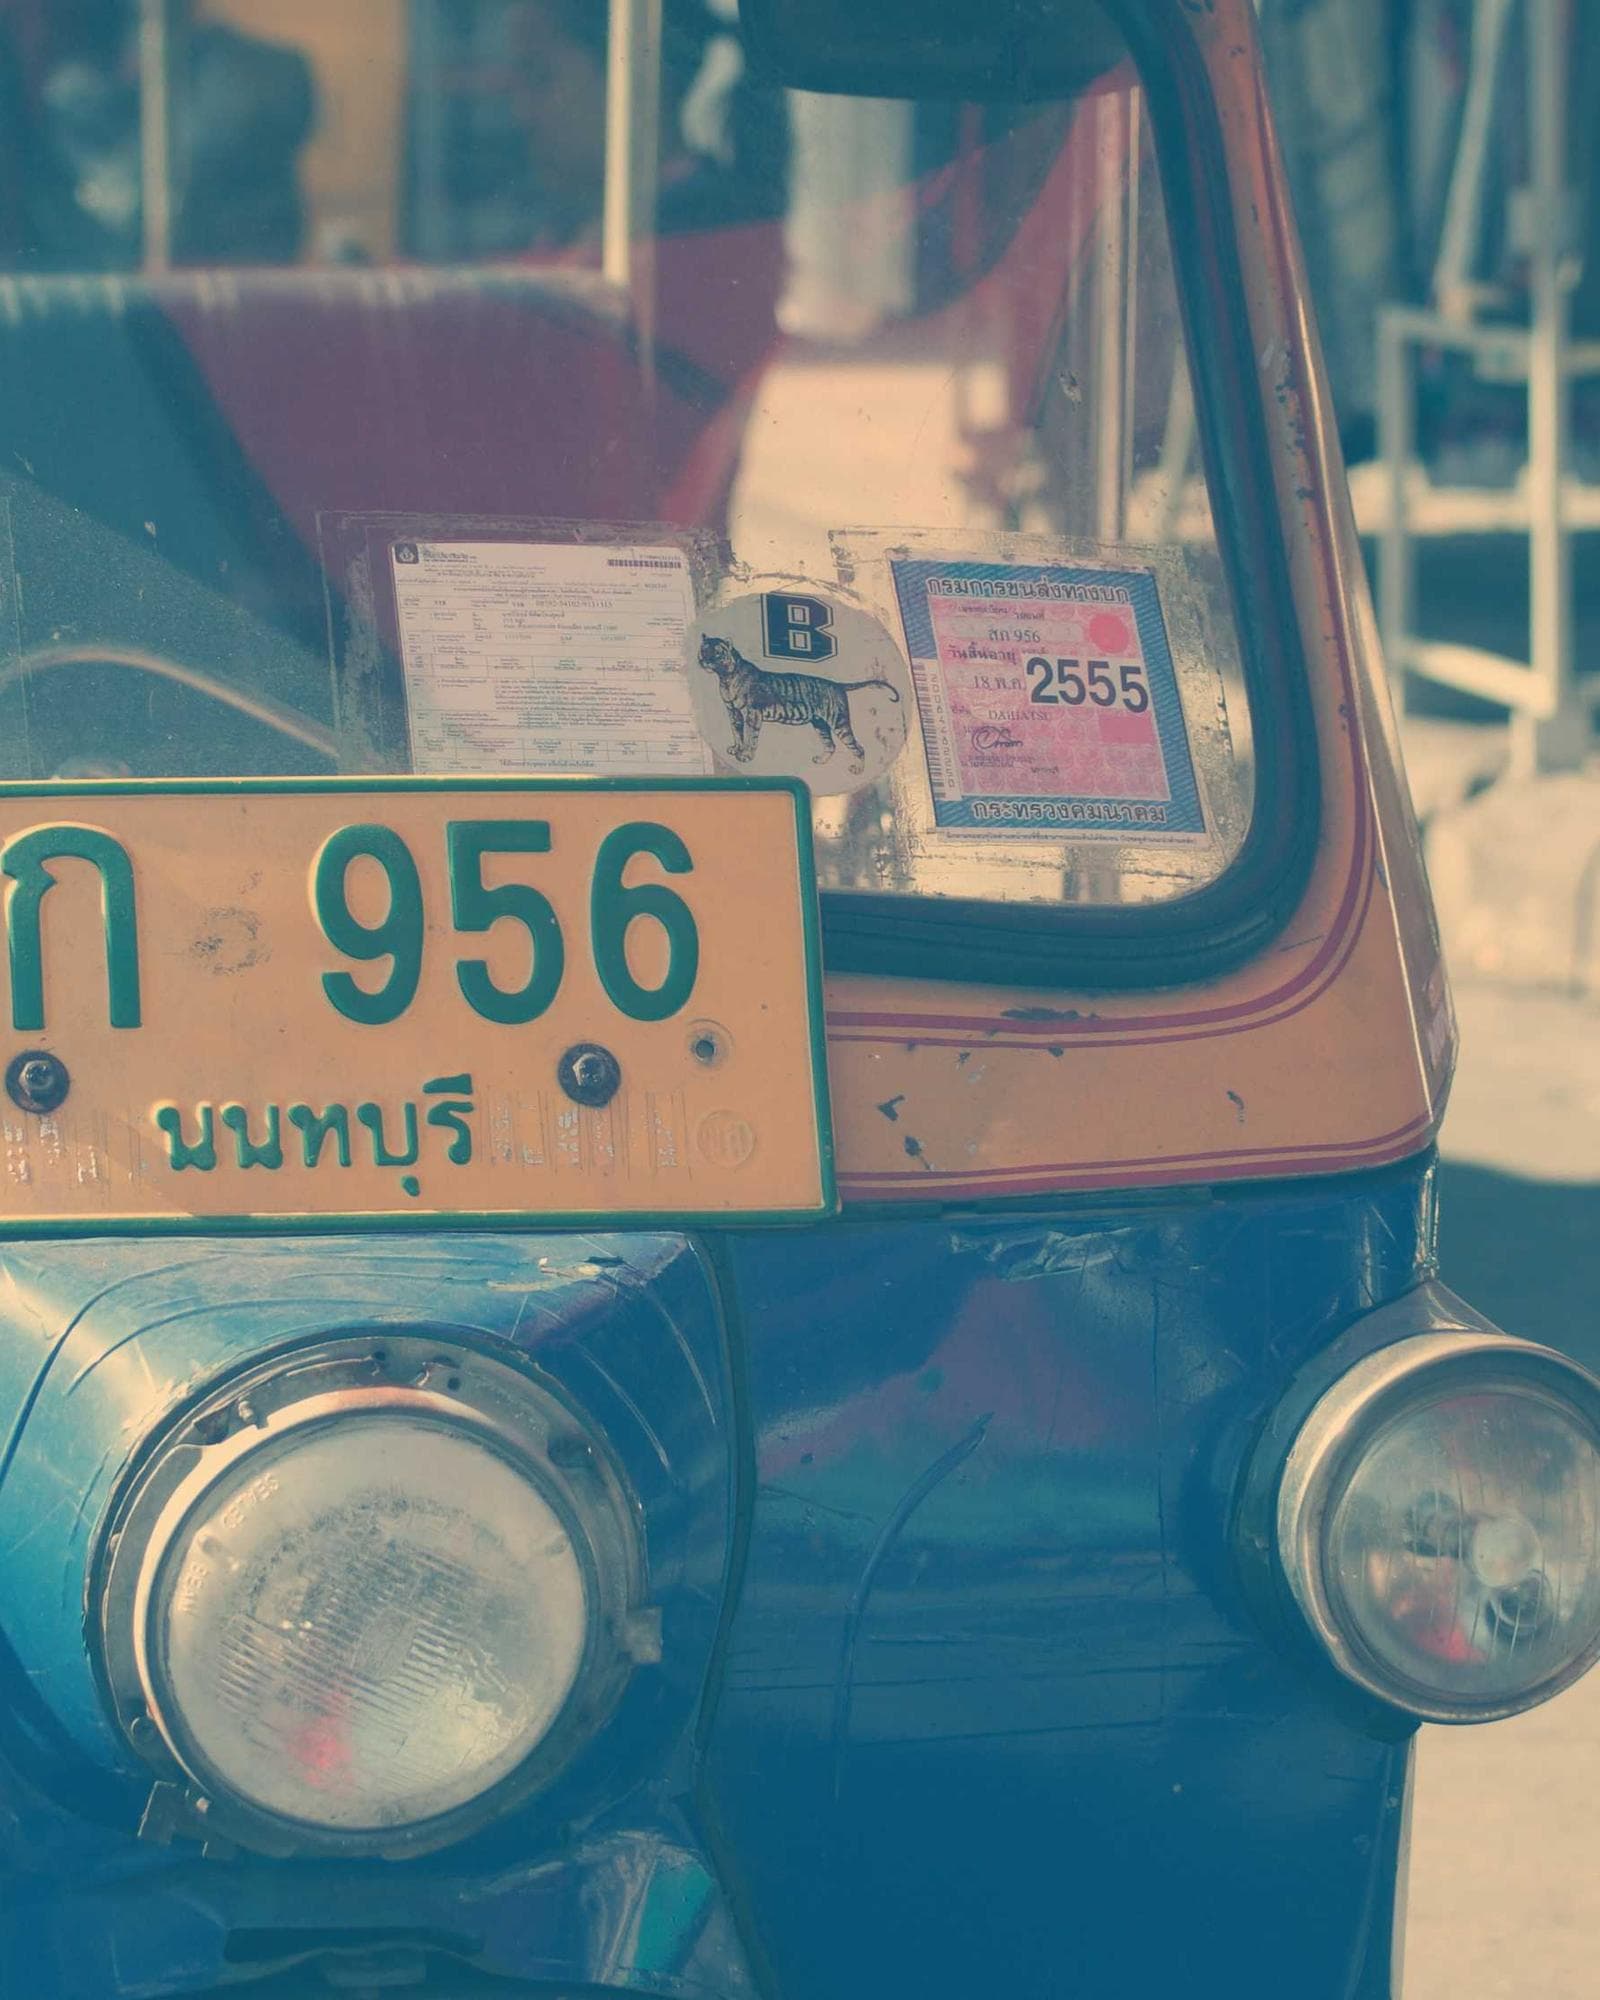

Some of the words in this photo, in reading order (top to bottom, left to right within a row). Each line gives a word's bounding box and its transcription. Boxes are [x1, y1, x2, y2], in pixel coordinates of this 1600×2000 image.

[927, 576, 1130, 604] กรมการขนส่งทางบก
[761, 591, 838, 663] B
[1014, 628, 1042, 643] 956
[1026, 656, 1149, 714] 2555
[972, 800, 1167, 823] กระทรวงคมนาคม
[2, 822, 142, 1030] ก
[315, 820, 701, 1026] 956
[157, 1073, 474, 1197] นนทบุรี
